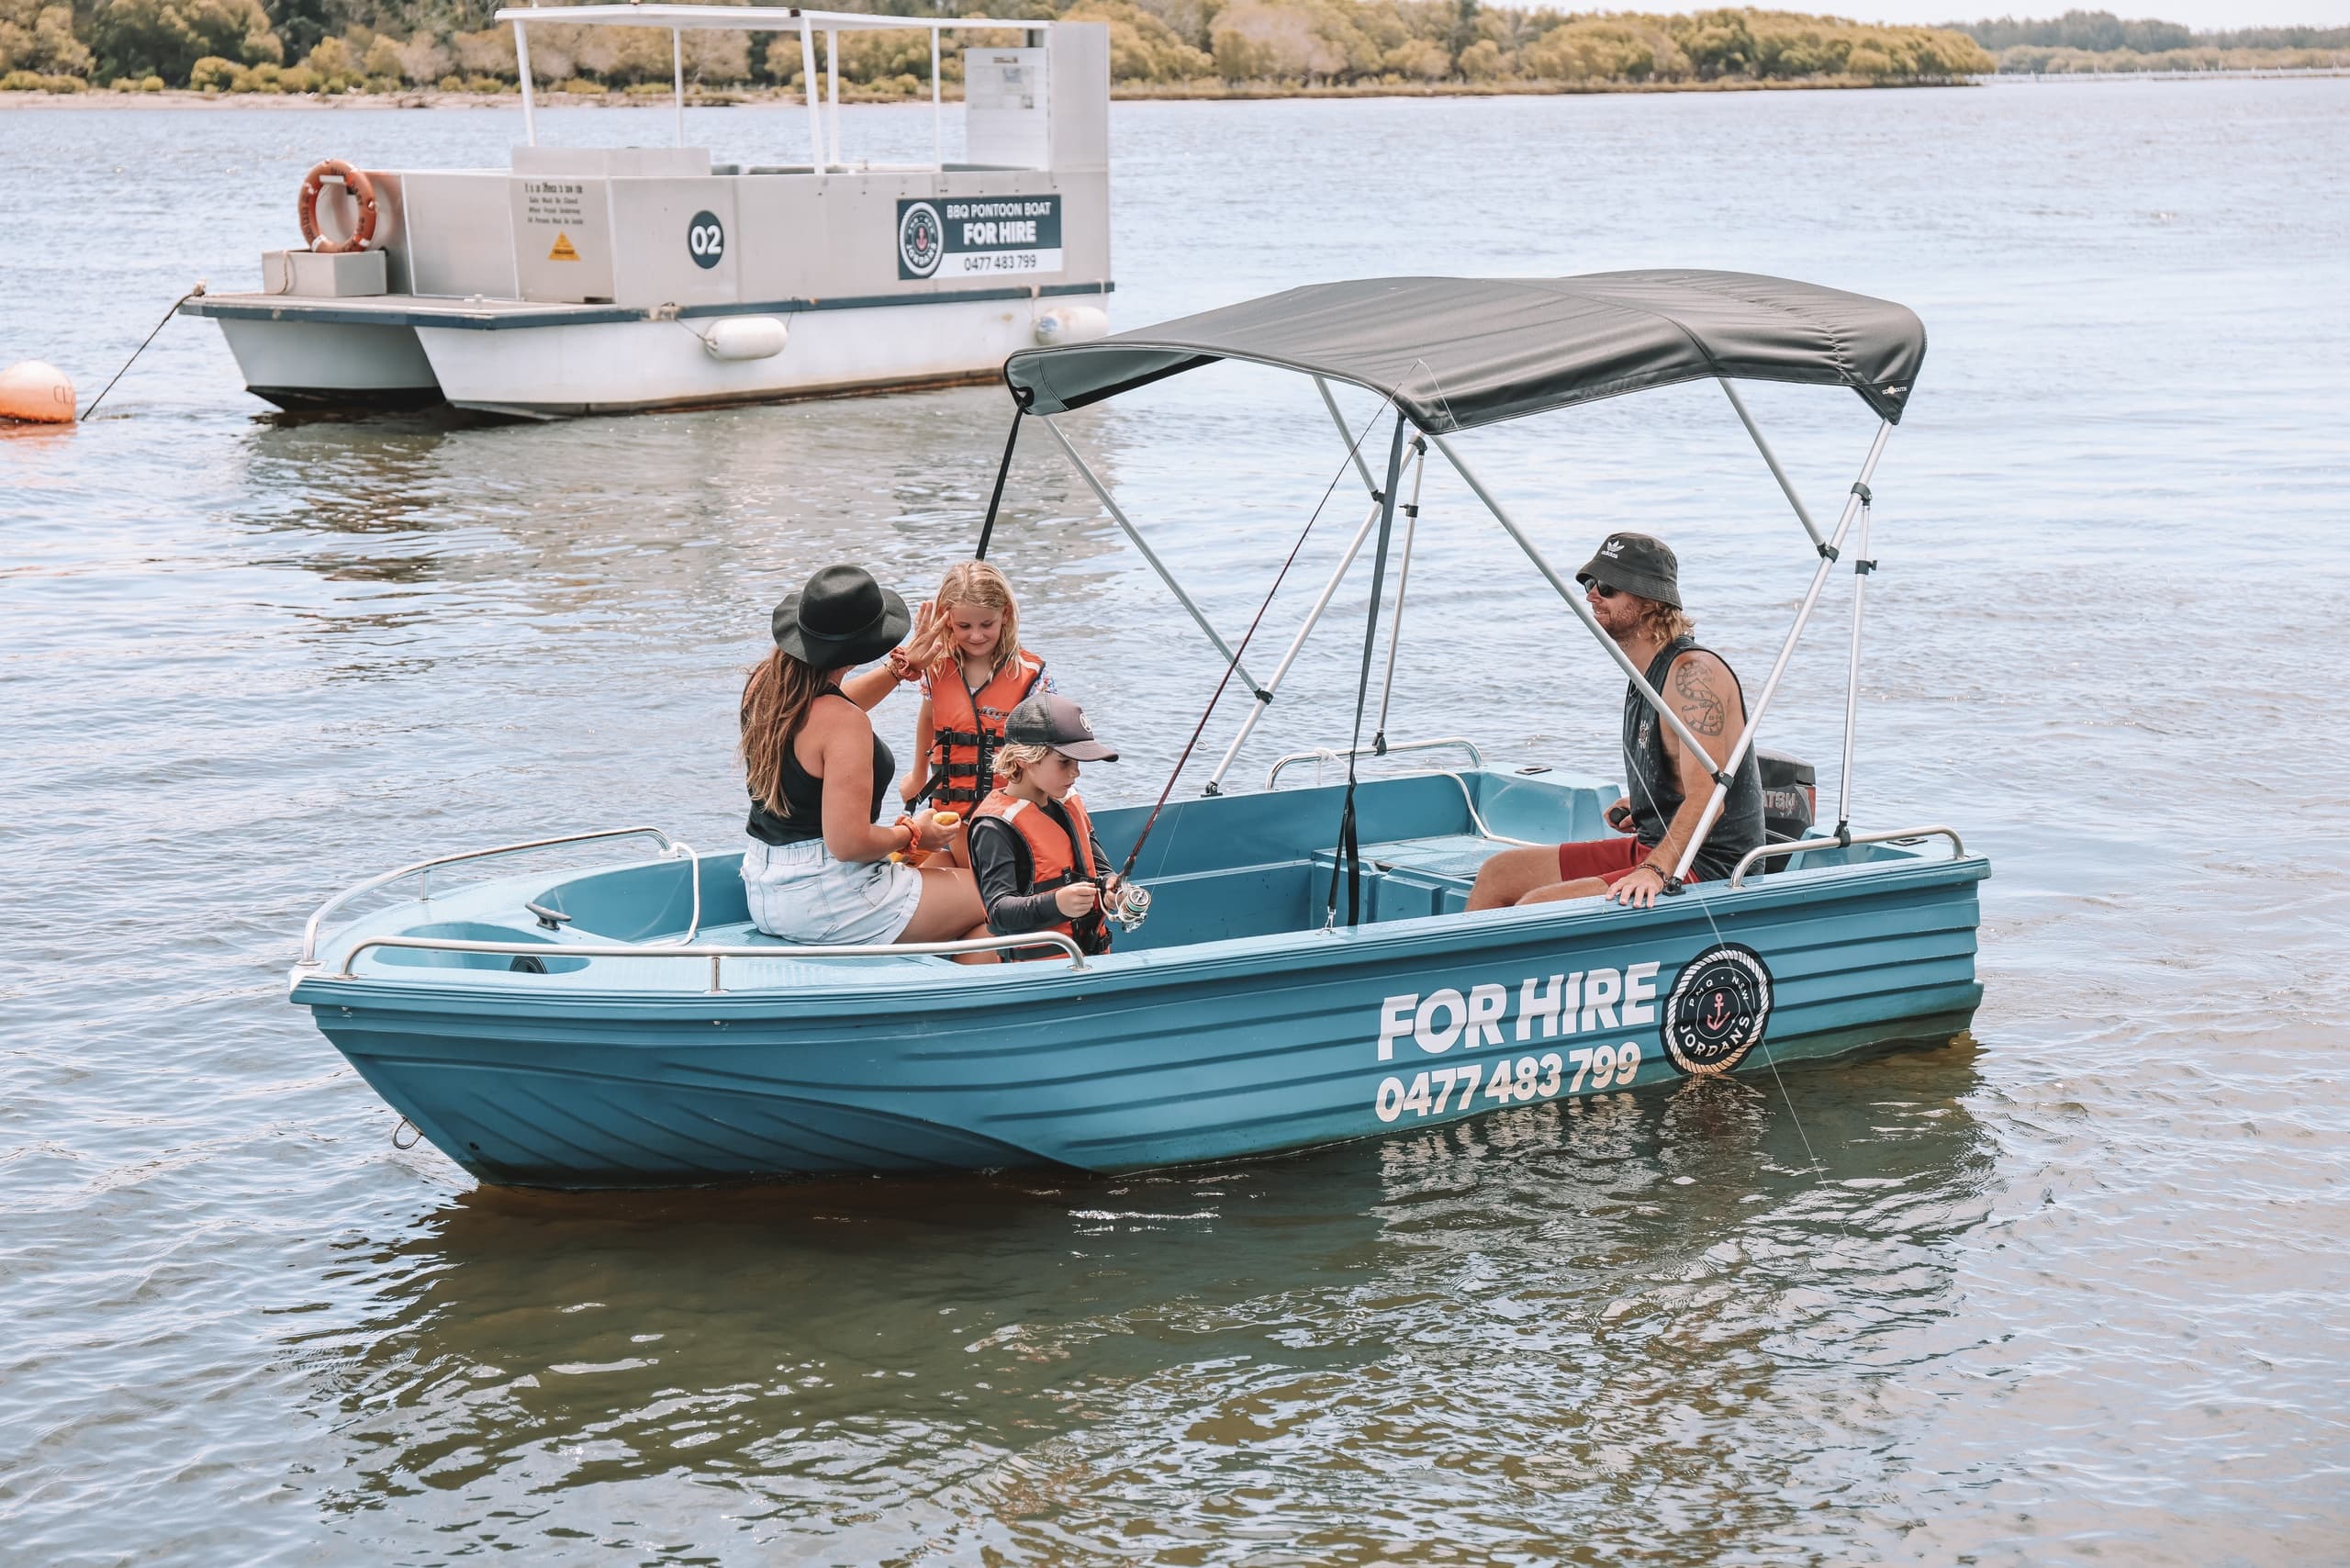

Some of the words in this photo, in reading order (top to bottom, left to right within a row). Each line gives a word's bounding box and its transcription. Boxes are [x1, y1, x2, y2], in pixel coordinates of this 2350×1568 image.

[946, 205, 969, 219] BBQ
[971, 203, 1023, 218] PONTOON
[1024, 201, 1052, 217] BOAT
[690, 225, 722, 255] 02
[963, 222, 998, 245] FOR
[999, 220, 1037, 244] HIRE
[964, 256, 991, 271] 0477
[994, 254, 1014, 269] 483
[1017, 253, 1036, 268] 799
[1688, 979, 1714, 1007] PMQ
[1731, 976, 1750, 1001] NSW
[1378, 983, 1507, 1061] FOR
[1516, 961, 1661, 1041] HIRE
[1680, 1015, 1751, 1058] JORDANS
[1375, 1064, 1482, 1123] 0477
[1485, 1053, 1563, 1103] 483
[1568, 1041, 1641, 1093] 799
